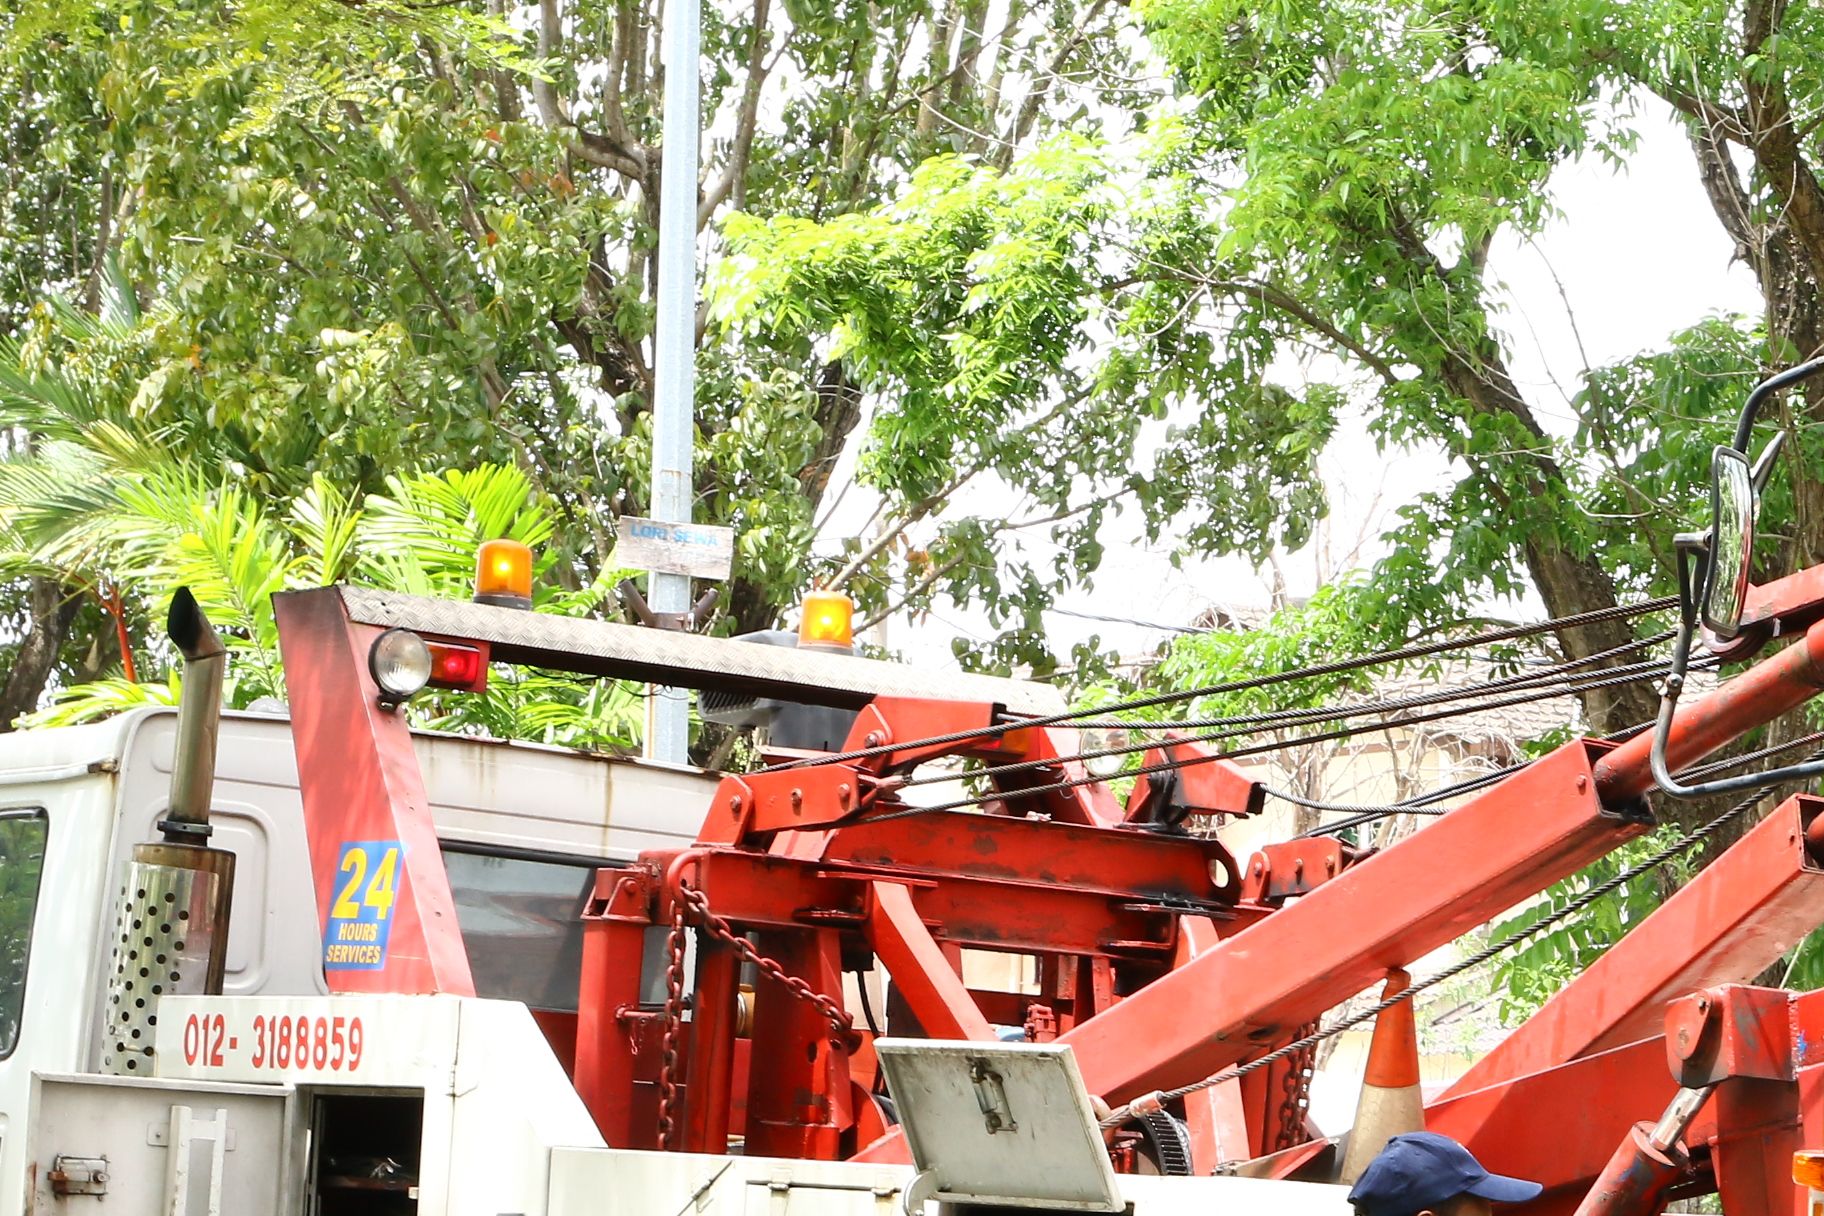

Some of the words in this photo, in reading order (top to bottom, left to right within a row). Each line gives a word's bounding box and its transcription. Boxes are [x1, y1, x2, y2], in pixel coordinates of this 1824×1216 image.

[331, 847, 398, 920] 24
[338, 922, 378, 942] HOURS
[326, 945, 381, 964] SERVICES
[251, 1014, 363, 1072] 3188859
